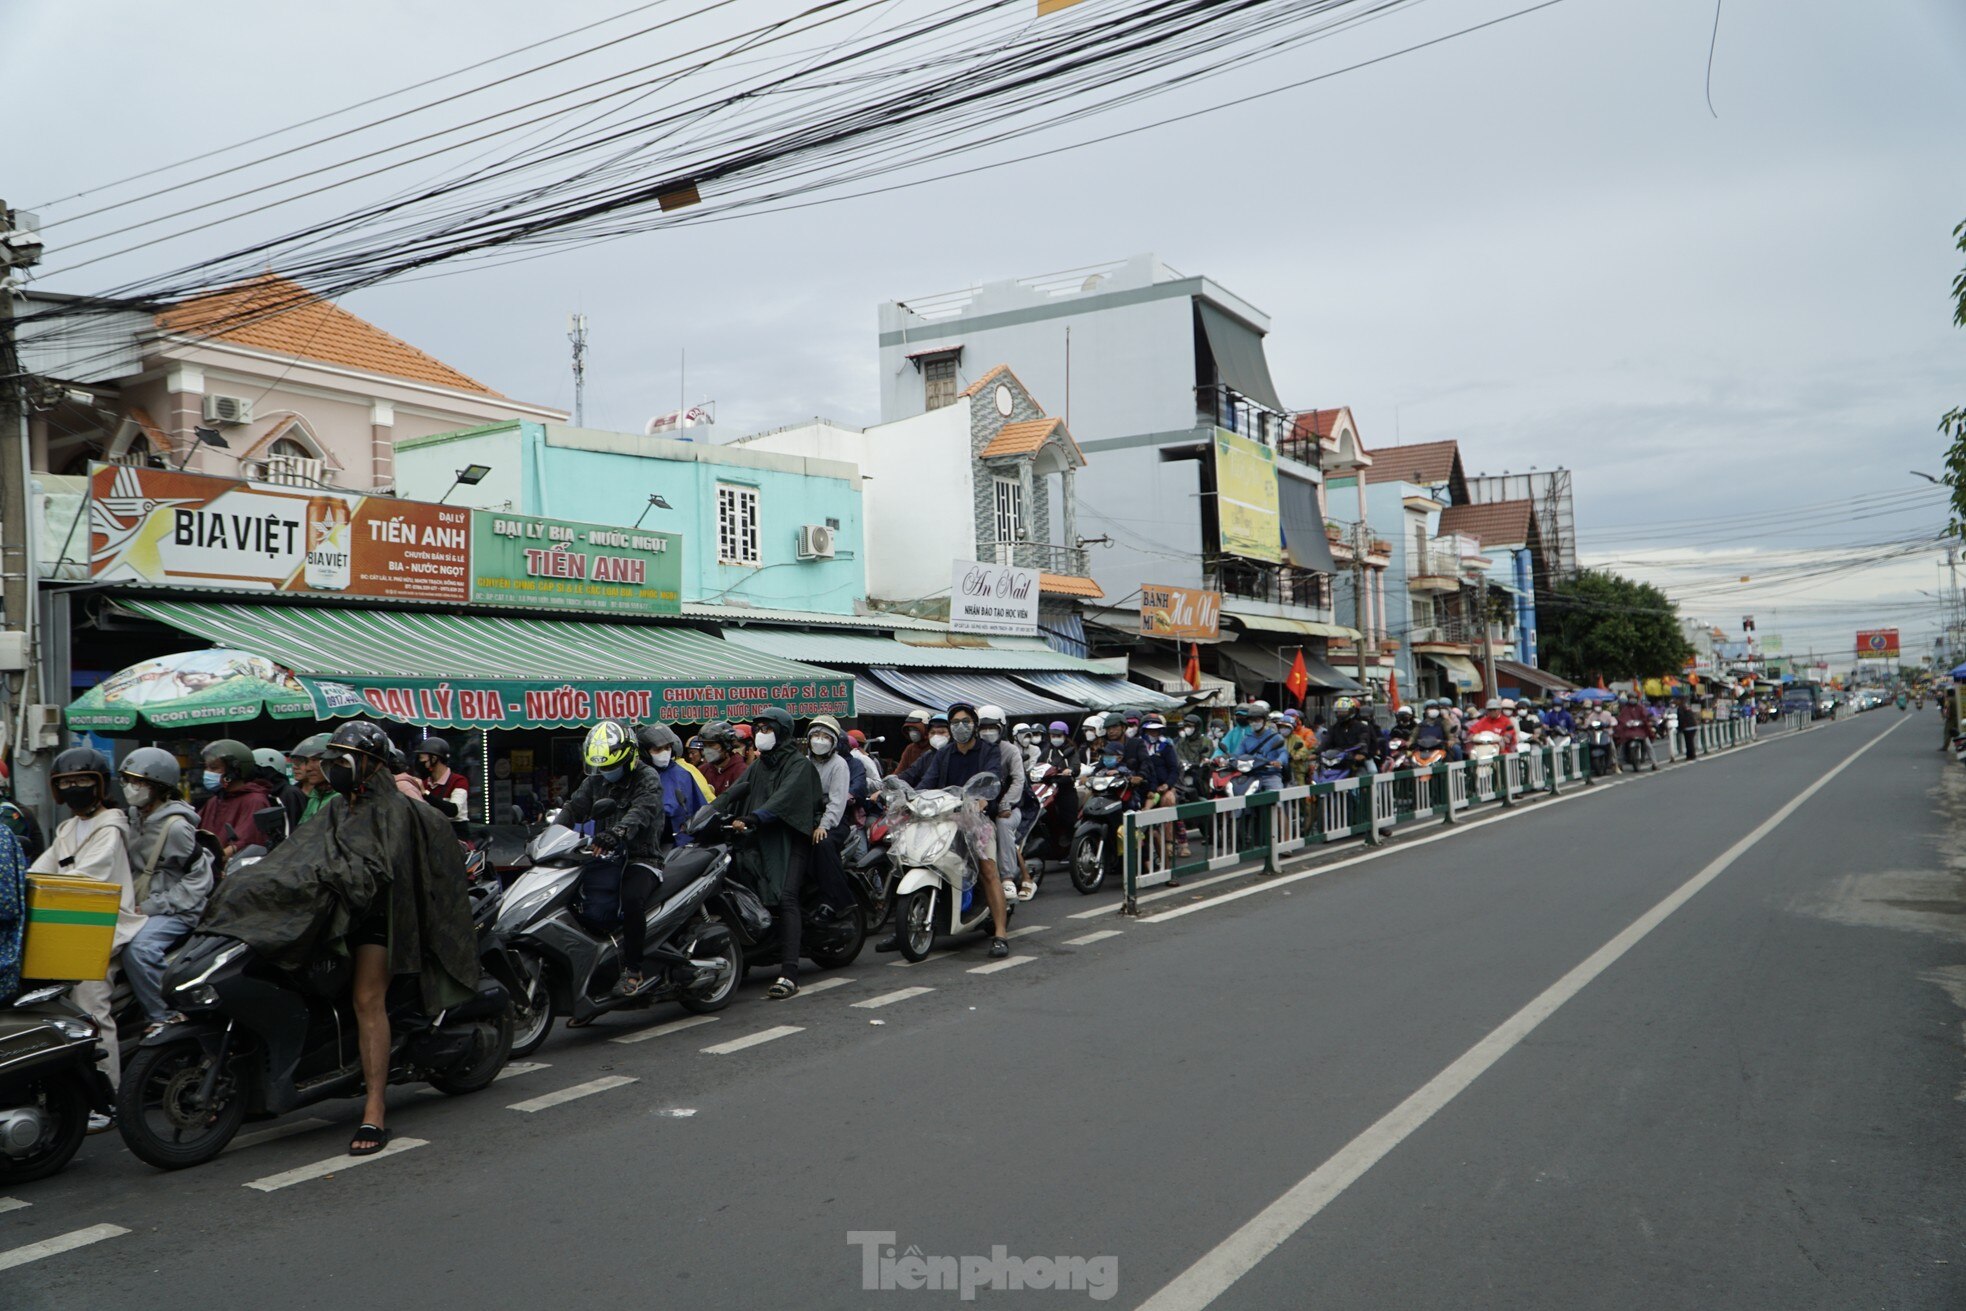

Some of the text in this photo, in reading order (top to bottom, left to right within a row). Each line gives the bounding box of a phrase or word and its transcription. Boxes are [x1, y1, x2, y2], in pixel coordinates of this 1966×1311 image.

[439, 512, 465, 524] ĐẠI LÝ
[368, 516, 466, 550] TIẾN ANH
[494, 519, 523, 538] ĐẠI
[526, 521, 545, 539] LÝ
[549, 526, 574, 542] BIA
[589, 529, 629, 548] NƯỚC
[632, 537, 668, 555] NGỌT
[404, 550, 431, 561] CHUYÊN
[431, 552, 444, 561] BÁN
[525, 542, 646, 584] TIẾN ANH
[388, 561, 404, 571] BIA
[411, 562, 438, 574] NƯỚC
[440, 565, 465, 577] NGỌT
[962, 565, 1031, 600] An Nail
[1143, 588, 1169, 608] BÁNH
[964, 603, 980, 617] NHẬN
[664, 685, 726, 702] CHUYÊN
[728, 687, 768, 700] CUNG
[772, 683, 800, 700] CẤP
[819, 686, 829, 698] &
[419, 683, 453, 720] LÝ
[458, 690, 505, 721] BIA
[525, 685, 589, 721] NƯỚC
[594, 690, 652, 724] NGỌT
[660, 703, 680, 720] CÁC
[703, 705, 719, 719] BIA
[727, 702, 750, 718] NƯỚC
